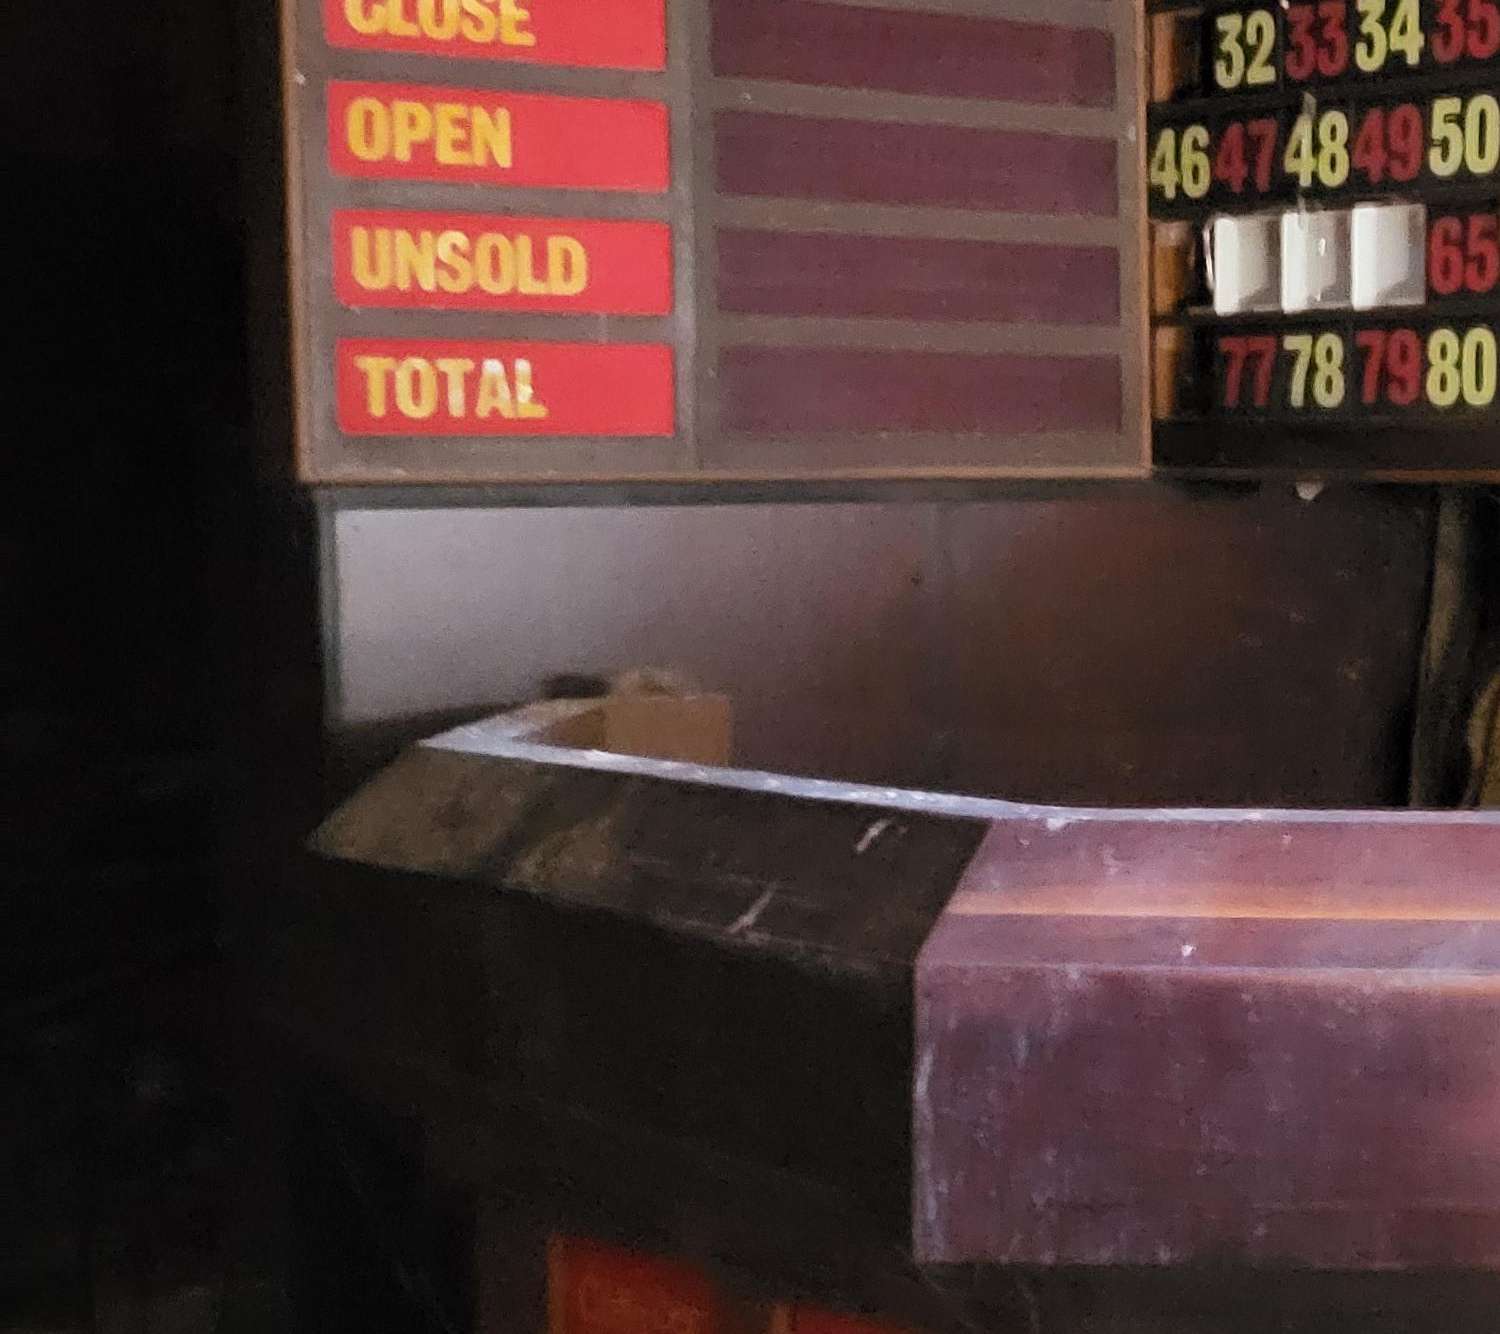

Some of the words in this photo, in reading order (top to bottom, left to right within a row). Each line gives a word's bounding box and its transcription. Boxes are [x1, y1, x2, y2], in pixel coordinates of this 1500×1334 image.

[1216, 11, 1275, 88] 32
[1287, 0, 1347, 78] 33
[346, 98, 512, 169] OPEN
[1150, 125, 1210, 199] 46
[1214, 120, 1277, 192] 47
[1285, 111, 1349, 186] 48
[1352, 104, 1423, 183] 49
[1430, 95, 1500, 175] 50
[351, 227, 587, 297] UNSOLD
[1430, 213, 1499, 293] 65
[354, 355, 547, 420] TOTAL
[1221, 336, 1275, 407] 77
[1283, 334, 1344, 407] 78
[1355, 329, 1421, 406] 79
[1426, 327, 1496, 406] 80
